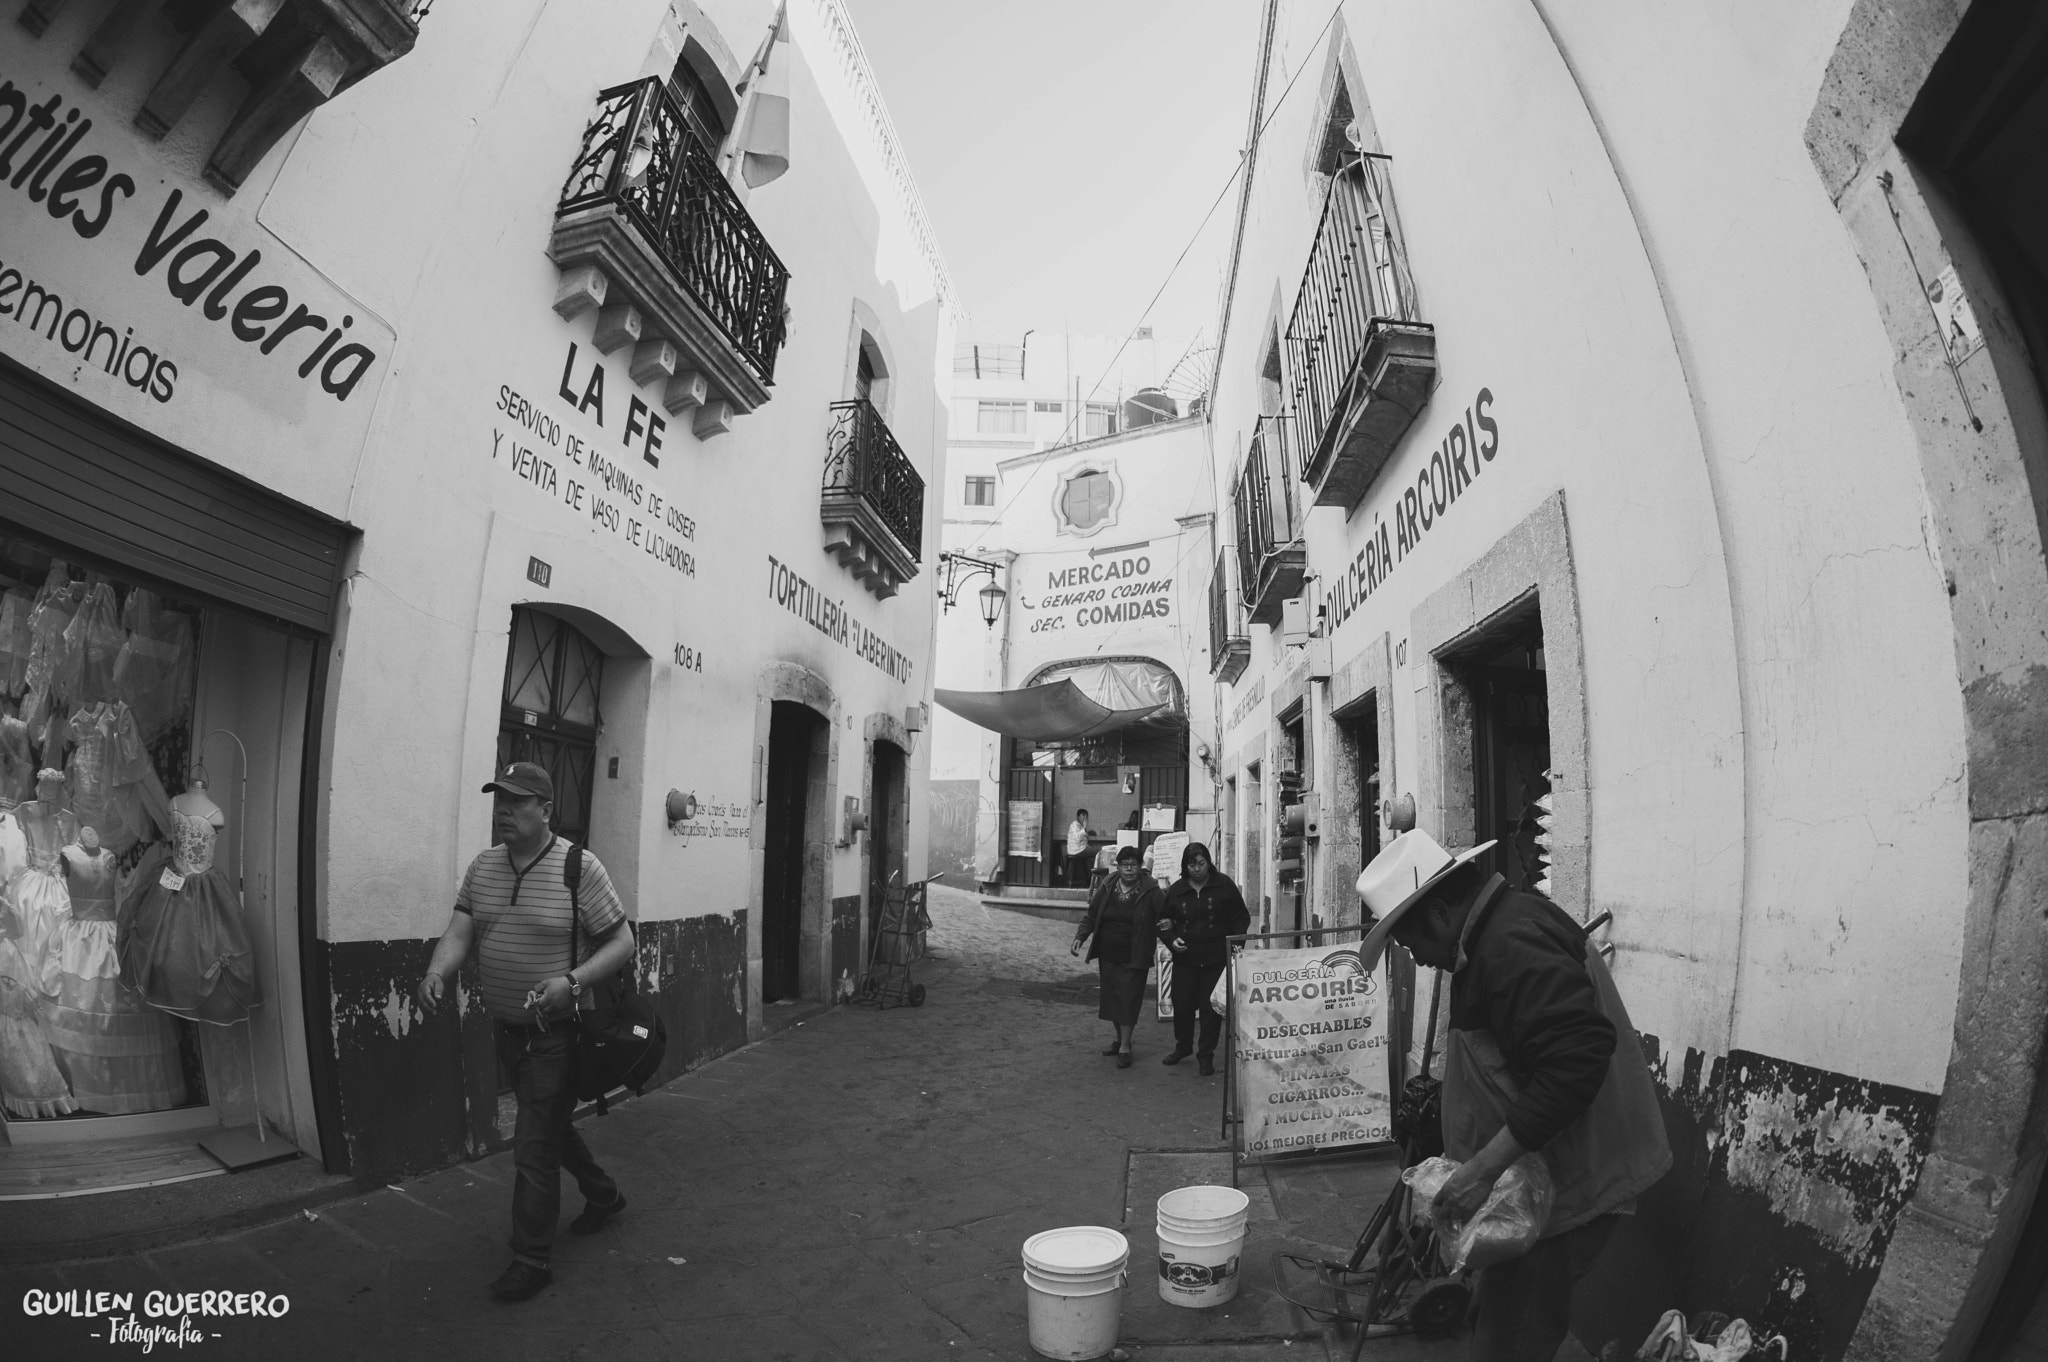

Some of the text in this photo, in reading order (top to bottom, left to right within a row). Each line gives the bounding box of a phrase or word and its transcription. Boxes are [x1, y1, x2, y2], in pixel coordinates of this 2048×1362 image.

[134, 188, 376, 402] Valeria
[558, 341, 667, 470] LA FE
[496, 384, 696, 542] SERVICIO DE MAQUINAS DE COSER
[492, 427, 696, 580] Y VENTA DE VASO DE LICUADORA
[1326, 386, 1499, 637] DULCERÍA ARCOIRIS
[1048, 556, 1151, 590] MERCADO
[768, 554, 849, 649] TORTILLERÍA
[1041, 578, 1173, 609] GENARO CODINA
[1076, 597, 1170, 627] COMIDAS
[674, 642, 702, 673] 108 A
[1249, 977, 1369, 1004] ARCOIRIS
[1256, 1016, 1372, 1040] DESECHABLES
[1244, 1046, 1307, 1062] Frituras
[1262, 1114, 1271, 1127] Y
[1275, 1107, 1334, 1125] MUCHO
[1272, 1132, 1328, 1149] MEJORES
